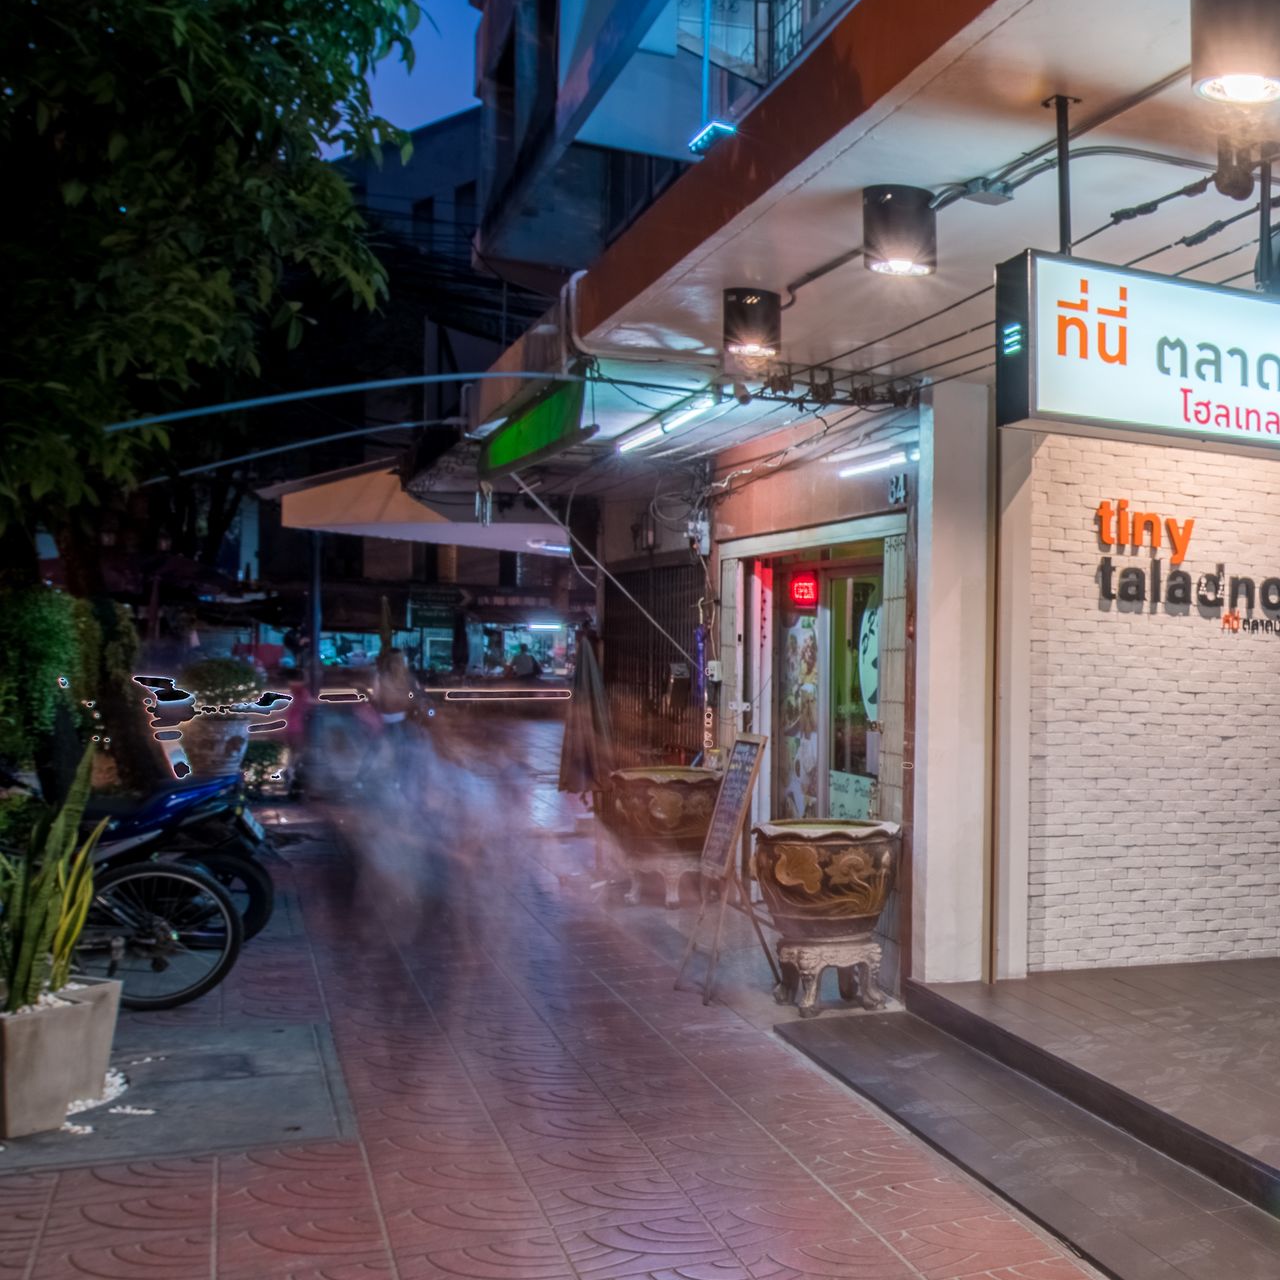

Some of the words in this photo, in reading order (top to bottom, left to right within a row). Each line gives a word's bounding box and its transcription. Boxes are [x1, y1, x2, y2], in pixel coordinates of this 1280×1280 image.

[1057, 278, 1128, 366] ที่นี่
[1180, 387, 1280, 436] โฮลเทล
[888, 472, 905, 504] 84
[1096, 498, 1195, 565] tiny
